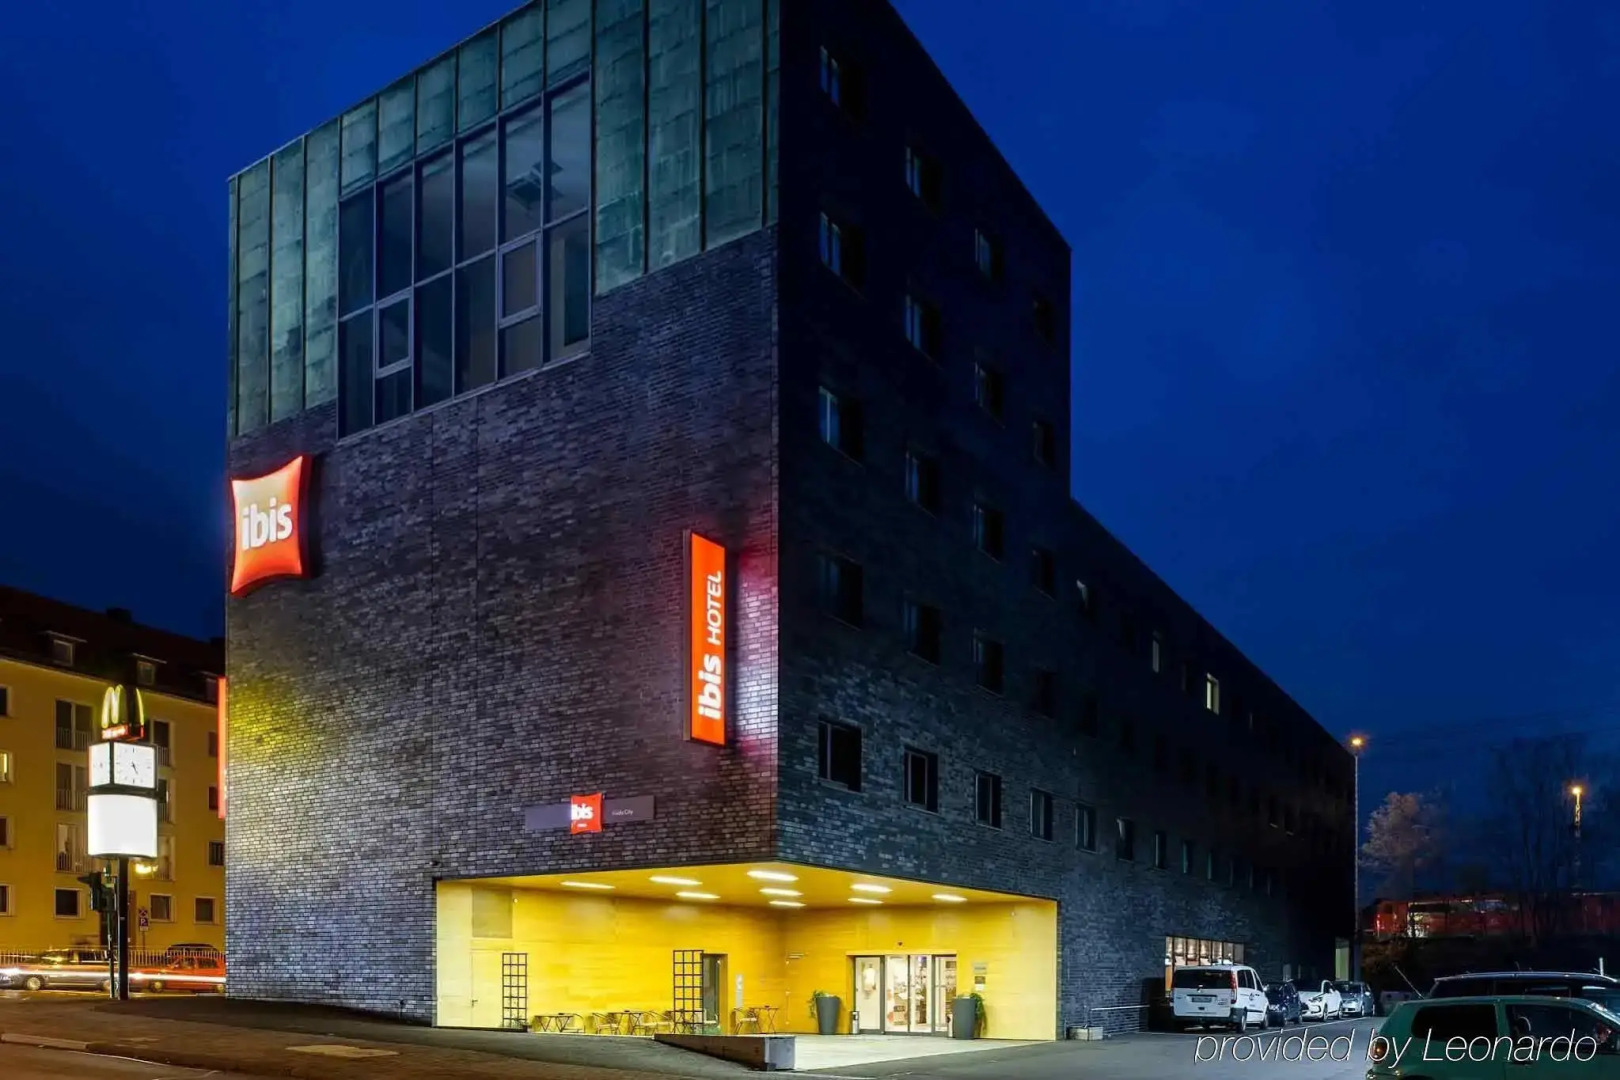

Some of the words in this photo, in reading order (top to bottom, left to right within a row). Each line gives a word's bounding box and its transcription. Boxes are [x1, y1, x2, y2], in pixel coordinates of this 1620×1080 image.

[241, 497, 292, 550] ibis
[706, 570, 722, 645] HOTEL
[698, 653, 722, 720] ibis
